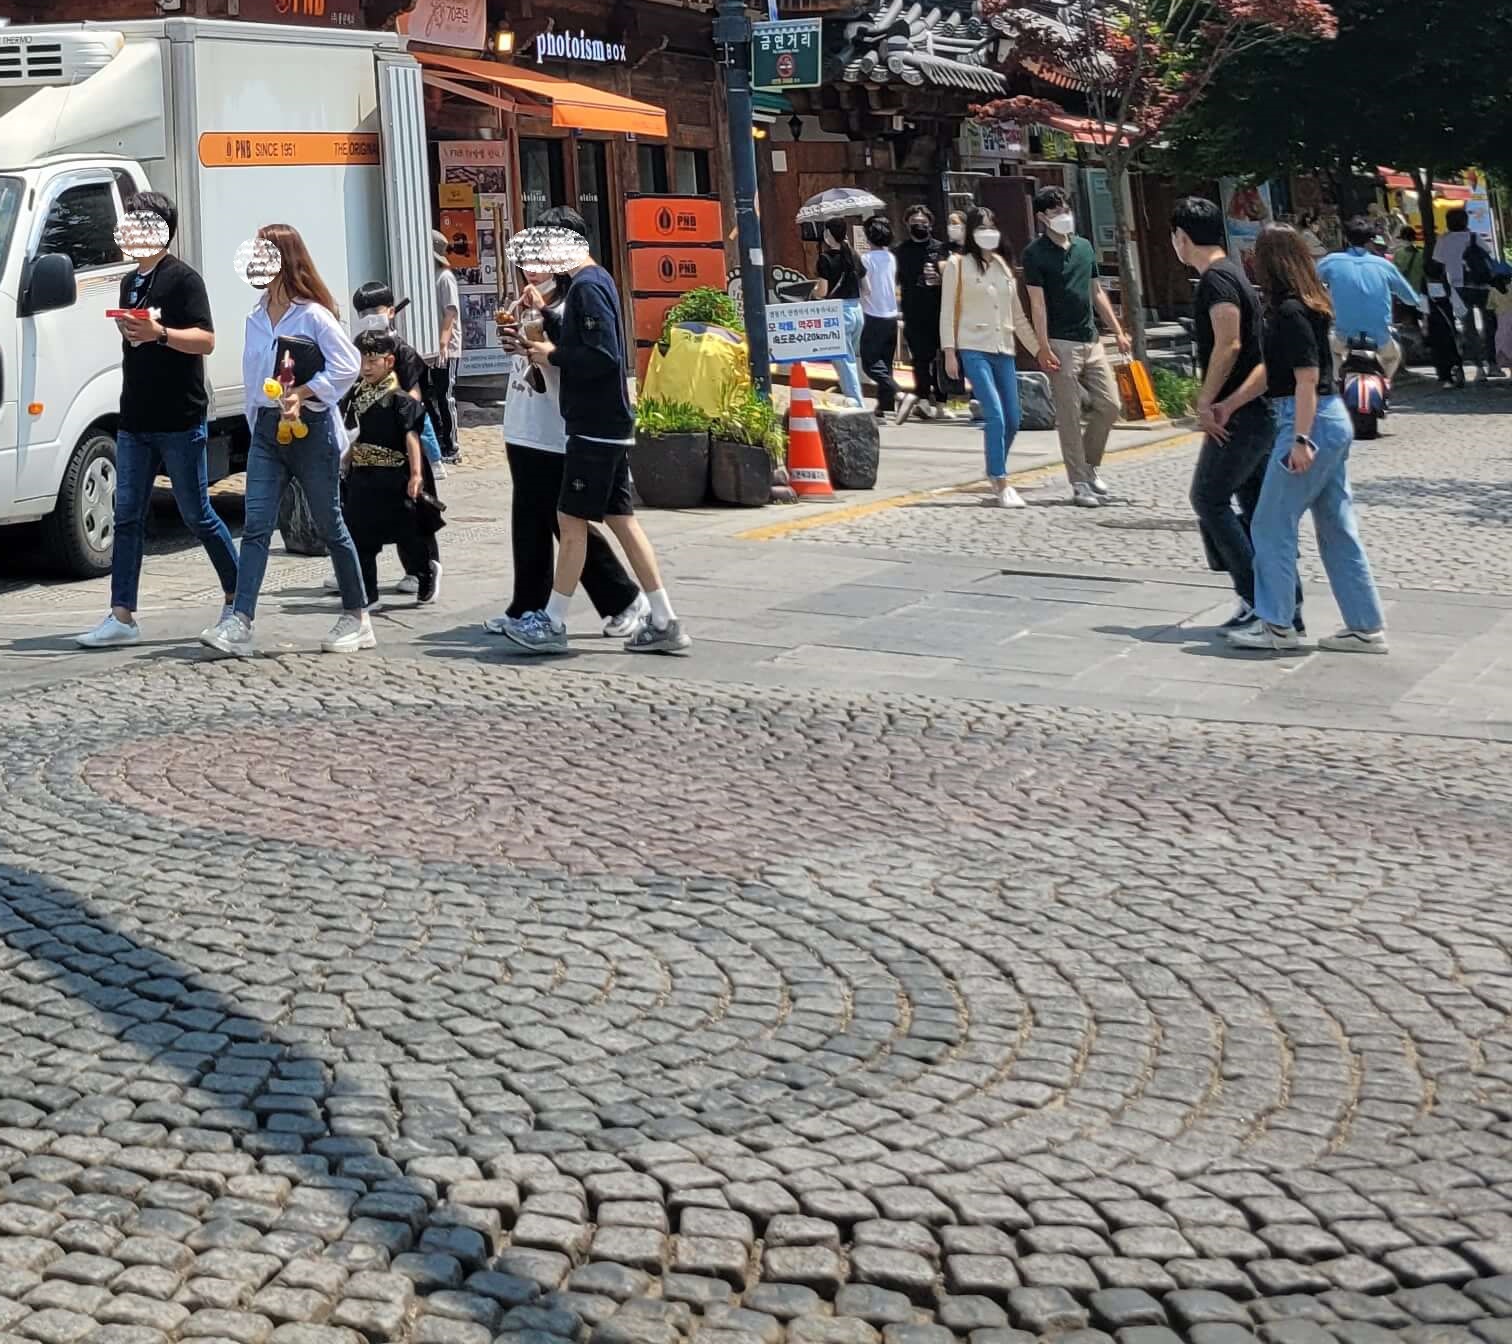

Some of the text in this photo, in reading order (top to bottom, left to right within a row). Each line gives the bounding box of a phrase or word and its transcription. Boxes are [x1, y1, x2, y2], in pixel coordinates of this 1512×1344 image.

[536, 28, 626, 64] photoism BOX
[759, 32, 811, 51] 금연거리
[235, 139, 252, 160] PNB
[255, 142, 278, 158] SINCE
[280, 143, 297, 158] 1951
[334, 142, 348, 157] THE
[676, 215, 697, 227] PNB
[678, 263, 697, 274] PNB
